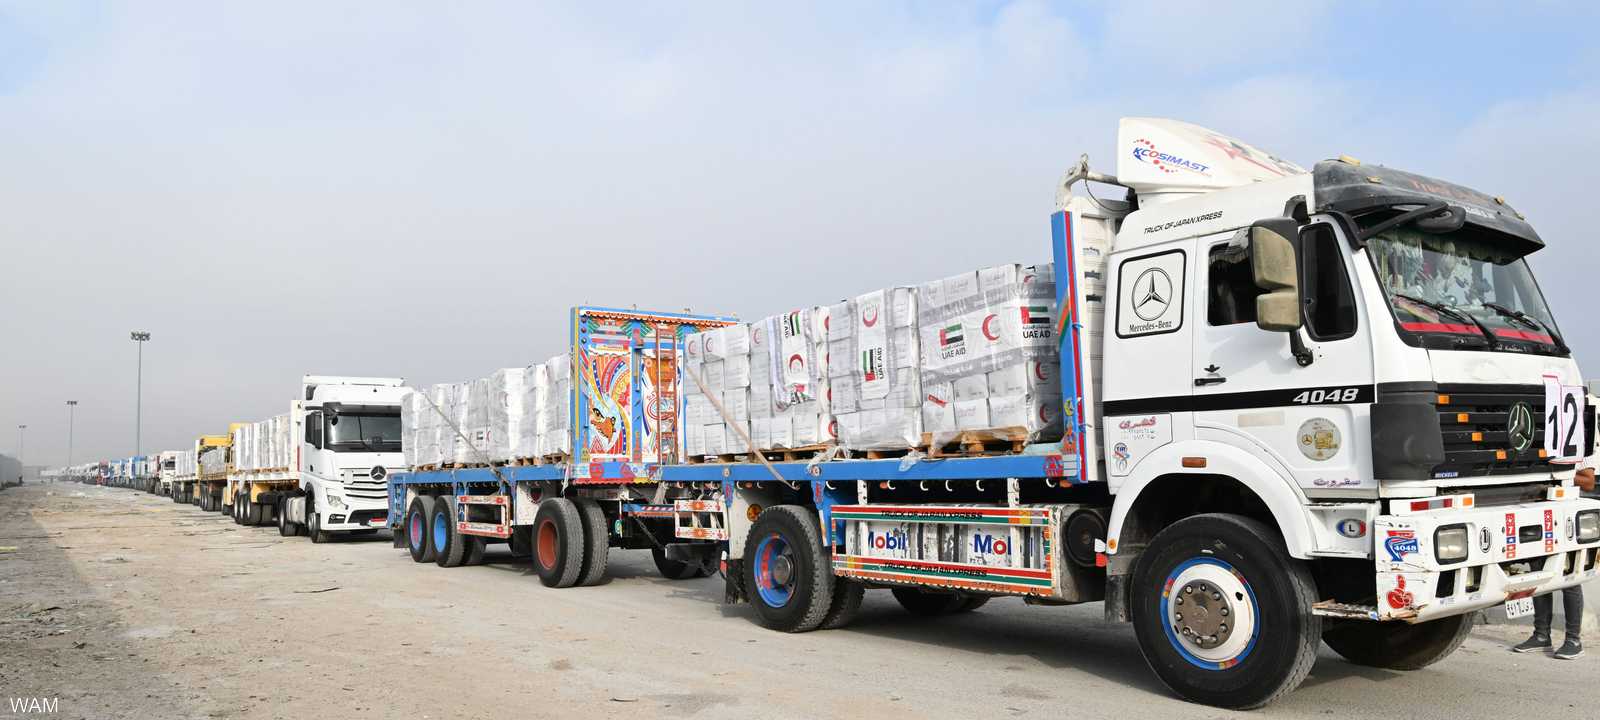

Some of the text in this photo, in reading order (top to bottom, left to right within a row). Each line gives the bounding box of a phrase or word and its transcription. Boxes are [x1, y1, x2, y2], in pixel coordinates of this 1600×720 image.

[1144, 211, 1223, 234] TRUCK OF JAPAN XPRESS
[1022, 330, 1039, 339] UAE
[941, 349, 955, 360] UAE
[955, 346, 966, 356] AID
[1293, 388, 1359, 404] 4048
[881, 510, 905, 518] TRUCK
[919, 511, 948, 519] JAPAN
[949, 511, 983, 520] XPRESS
[1348, 524, 1355, 532] L
[952, 567, 987, 577] XPRESS
